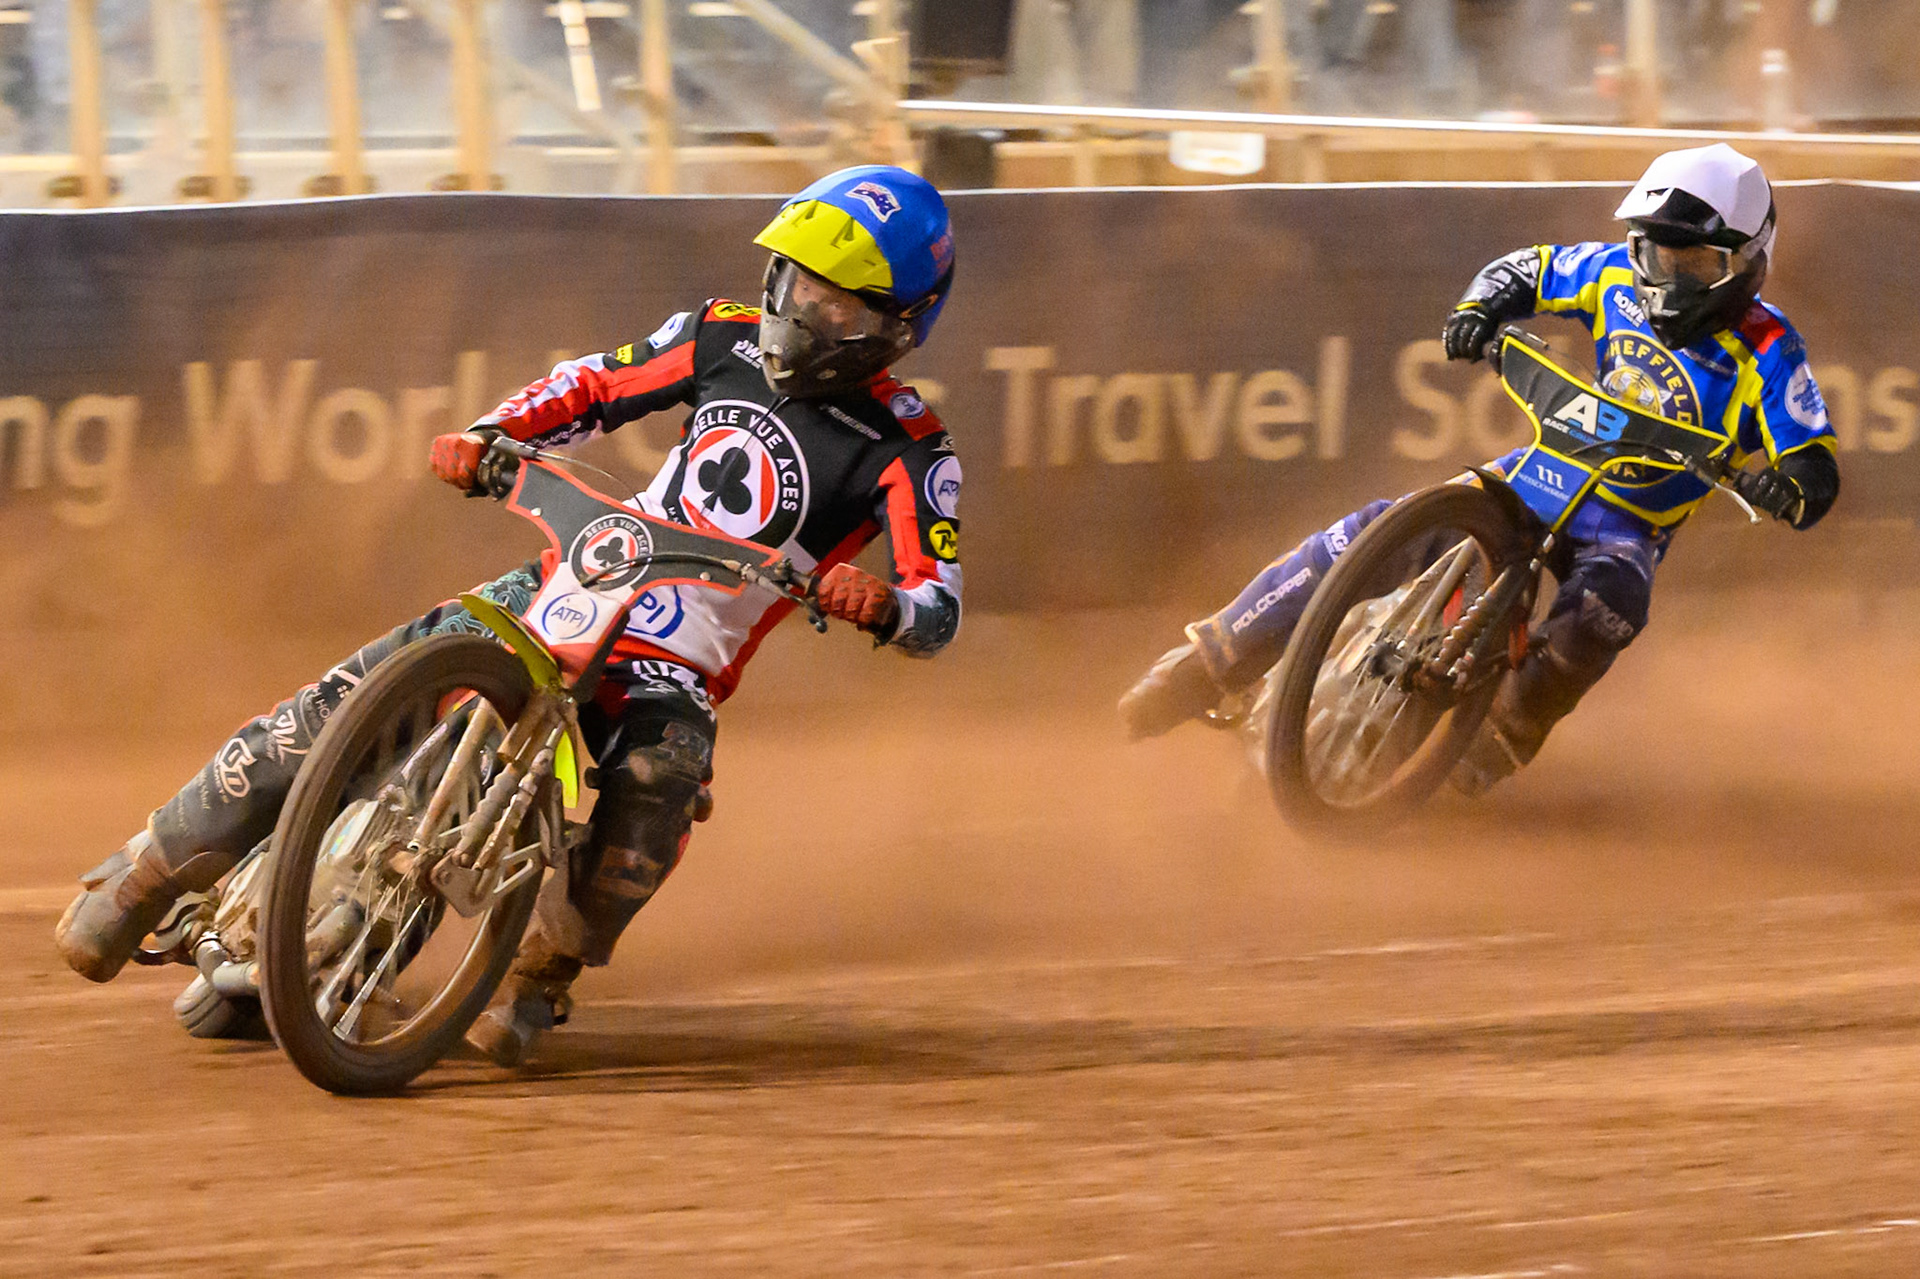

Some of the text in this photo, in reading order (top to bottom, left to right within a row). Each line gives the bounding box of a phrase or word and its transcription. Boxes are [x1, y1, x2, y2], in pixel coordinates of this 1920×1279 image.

[986, 336, 1350, 467] Travel
[1604, 339, 1692, 424] HEFFIELD
[1553, 392, 1629, 441] AB
[749, 414, 783, 450] VUE
[775, 458, 800, 512] ACES
[585, 519, 616, 538] BELLE
[619, 519, 639, 533] VUE
[551, 605, 588, 628] ATPI
[1232, 567, 1312, 634] POLCOPPER
